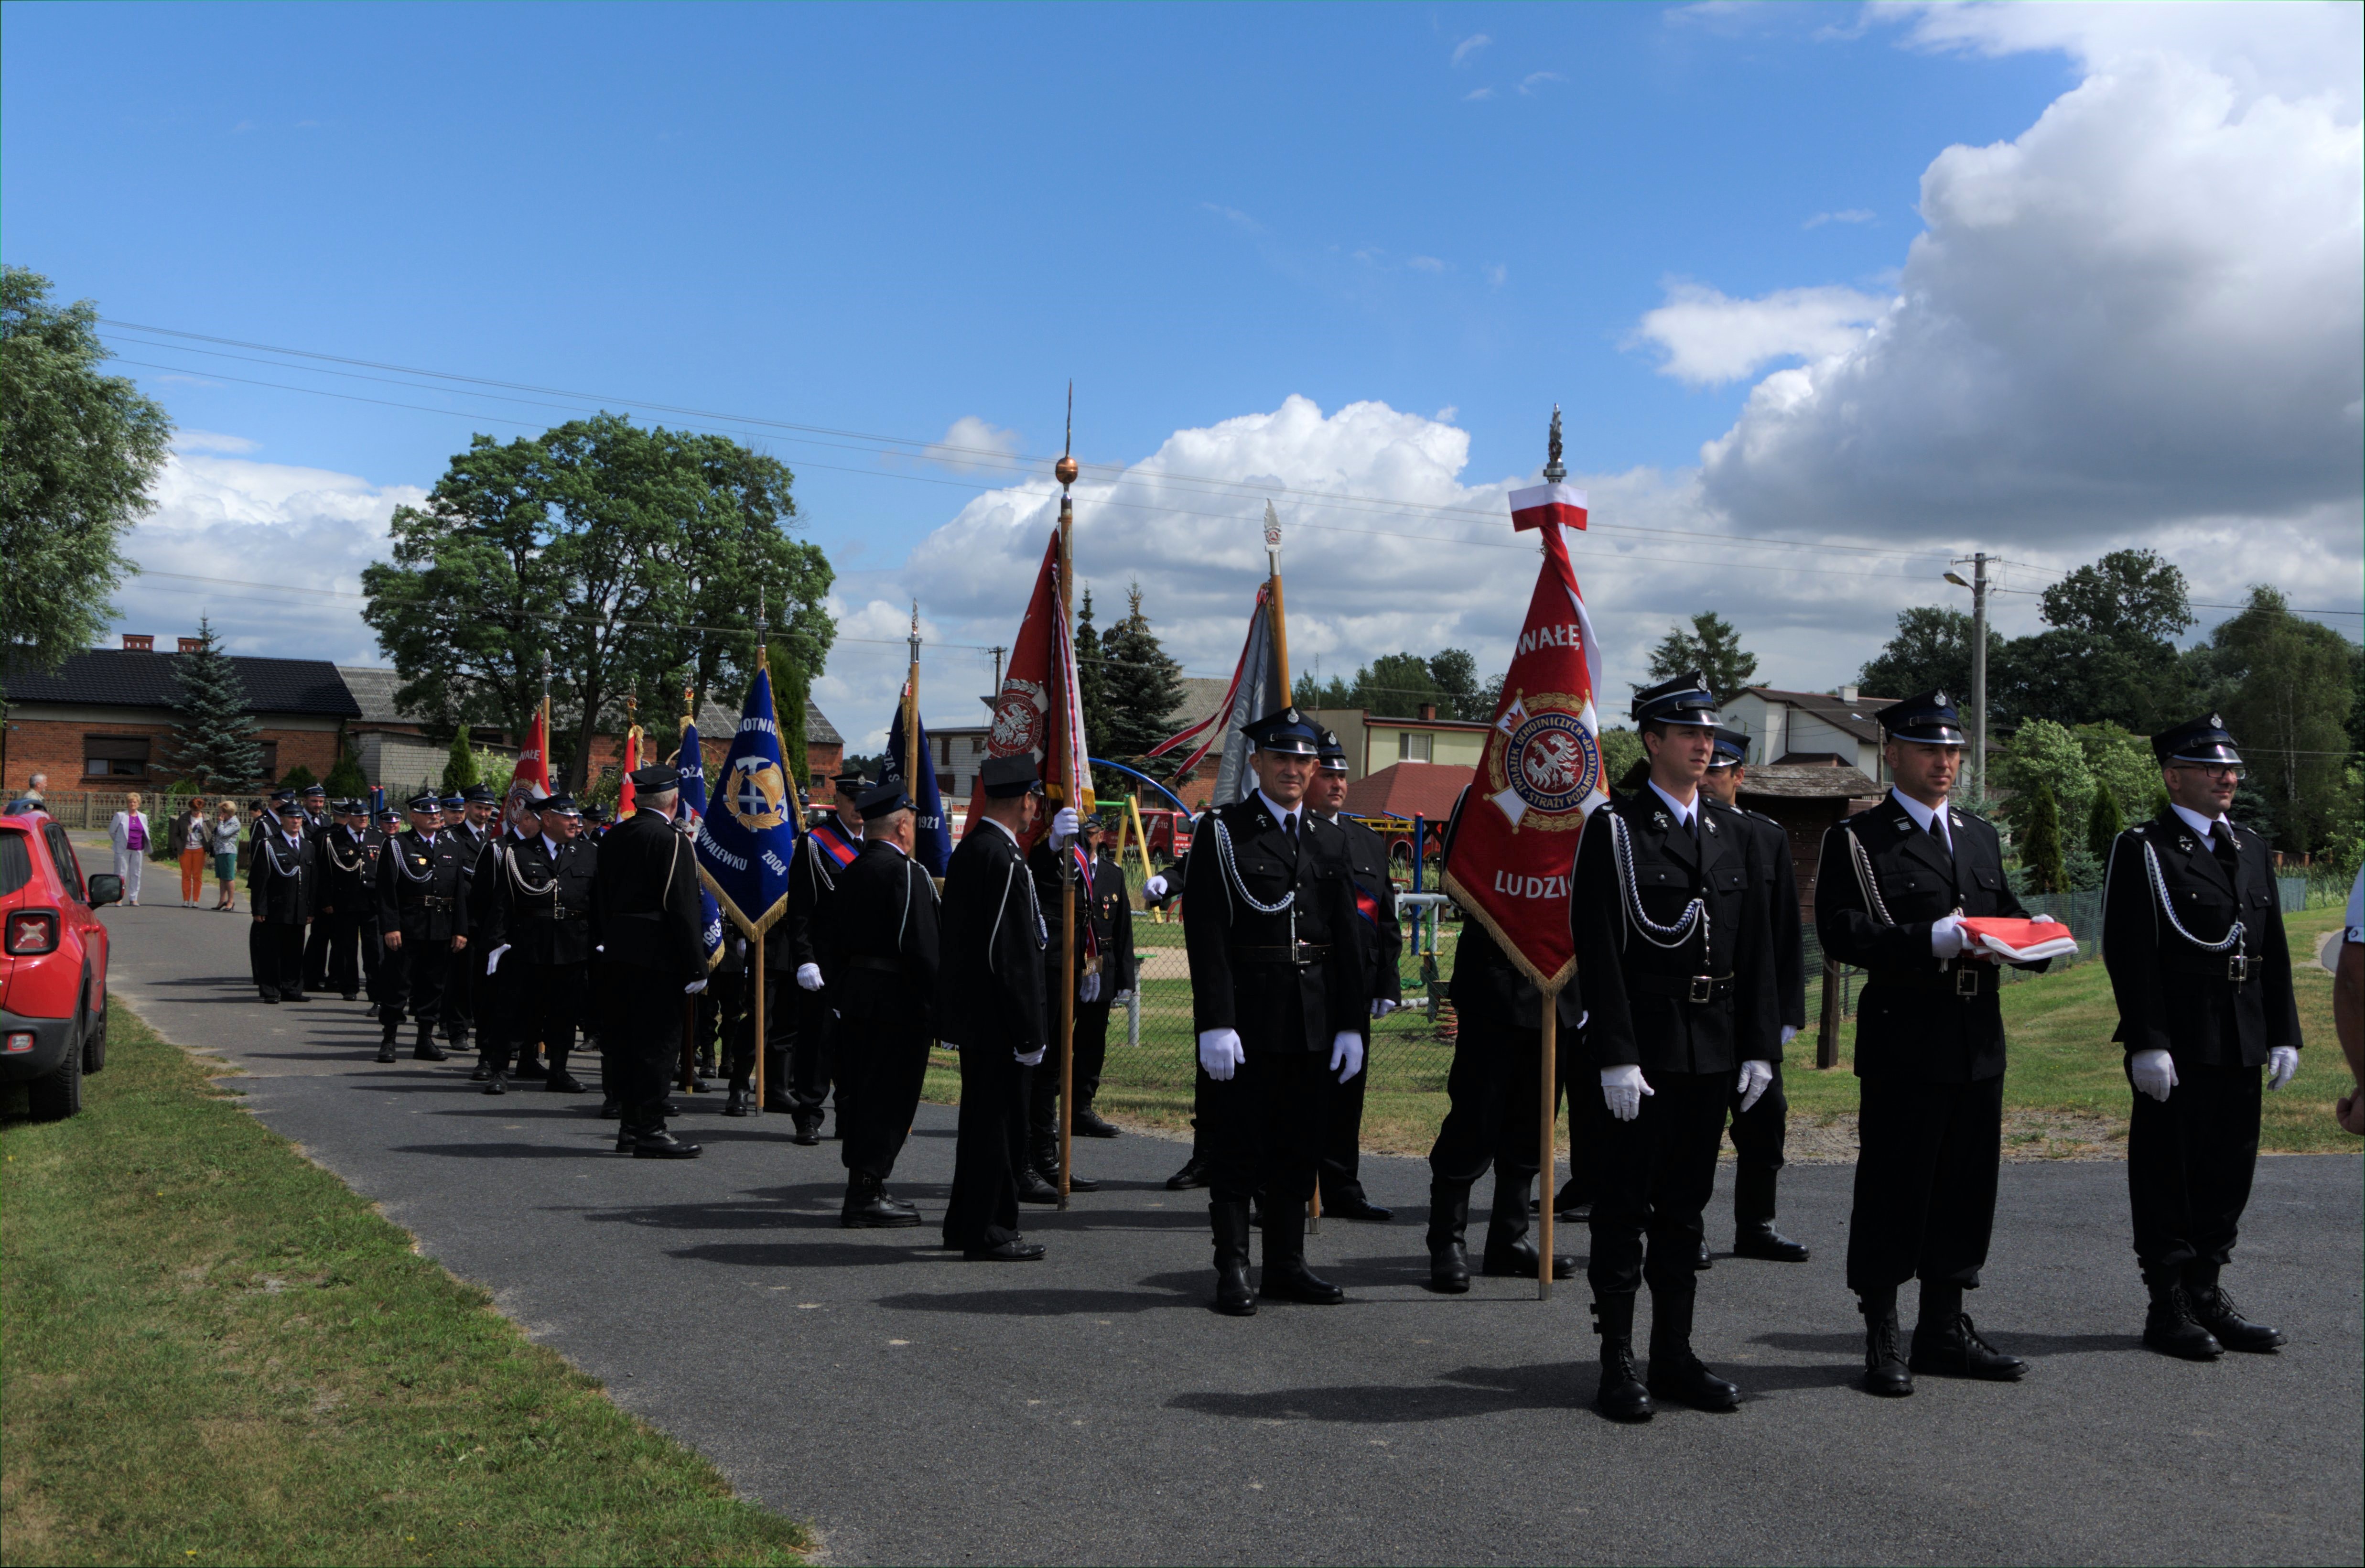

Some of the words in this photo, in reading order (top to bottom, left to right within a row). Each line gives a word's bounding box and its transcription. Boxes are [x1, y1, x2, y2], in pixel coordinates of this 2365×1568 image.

[1513, 624, 1580, 661] WAŁĘ
[1515, 717, 1585, 746] OCHOTNICZYCH
[676, 764, 703, 778] OŻA
[1510, 747, 1528, 793] ZWIĄZEK
[1528, 792, 1564, 808] STRAŻY
[1566, 753, 1597, 805] POŻARNYCH
[918, 816, 940, 829] 1921
[698, 824, 748, 871] OWALEWKU
[761, 850, 787, 876] 2004
[1494, 870, 1572, 898] LUDZI
[702, 919, 722, 947] 1965
